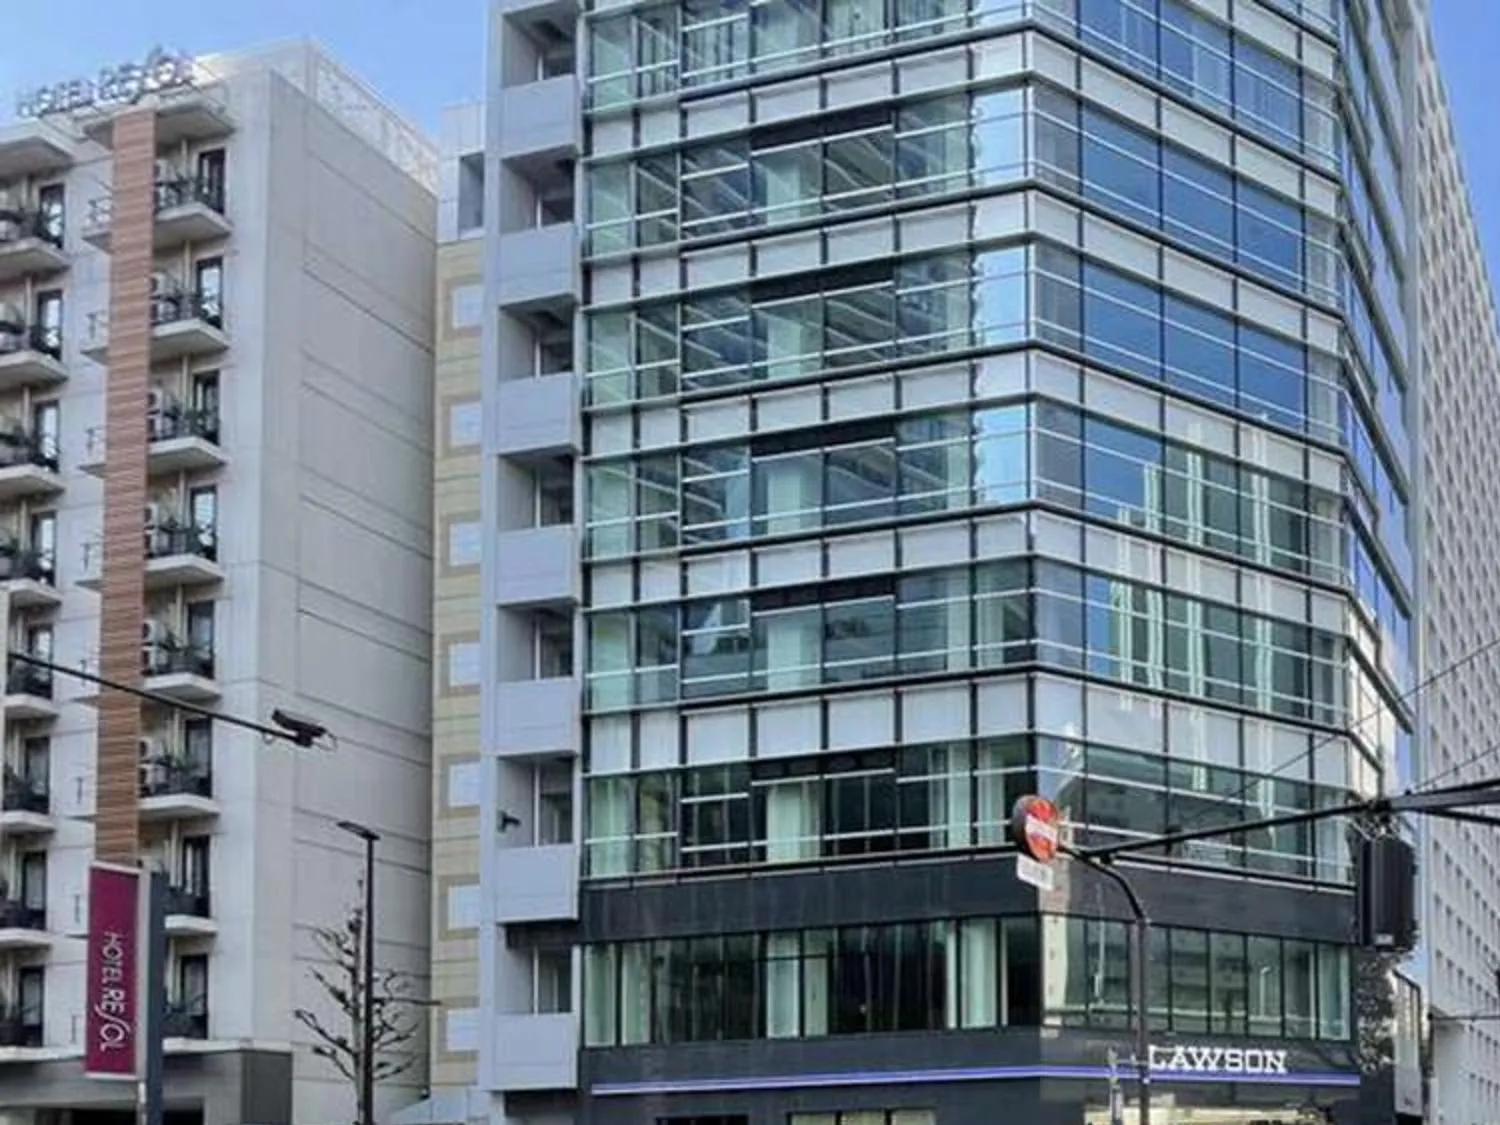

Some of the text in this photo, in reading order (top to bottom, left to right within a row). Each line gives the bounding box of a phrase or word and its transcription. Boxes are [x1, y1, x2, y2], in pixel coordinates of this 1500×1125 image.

[94, 931, 131, 1052] HOTEL RESOL
[1149, 1044, 1287, 1075] LAWSON
